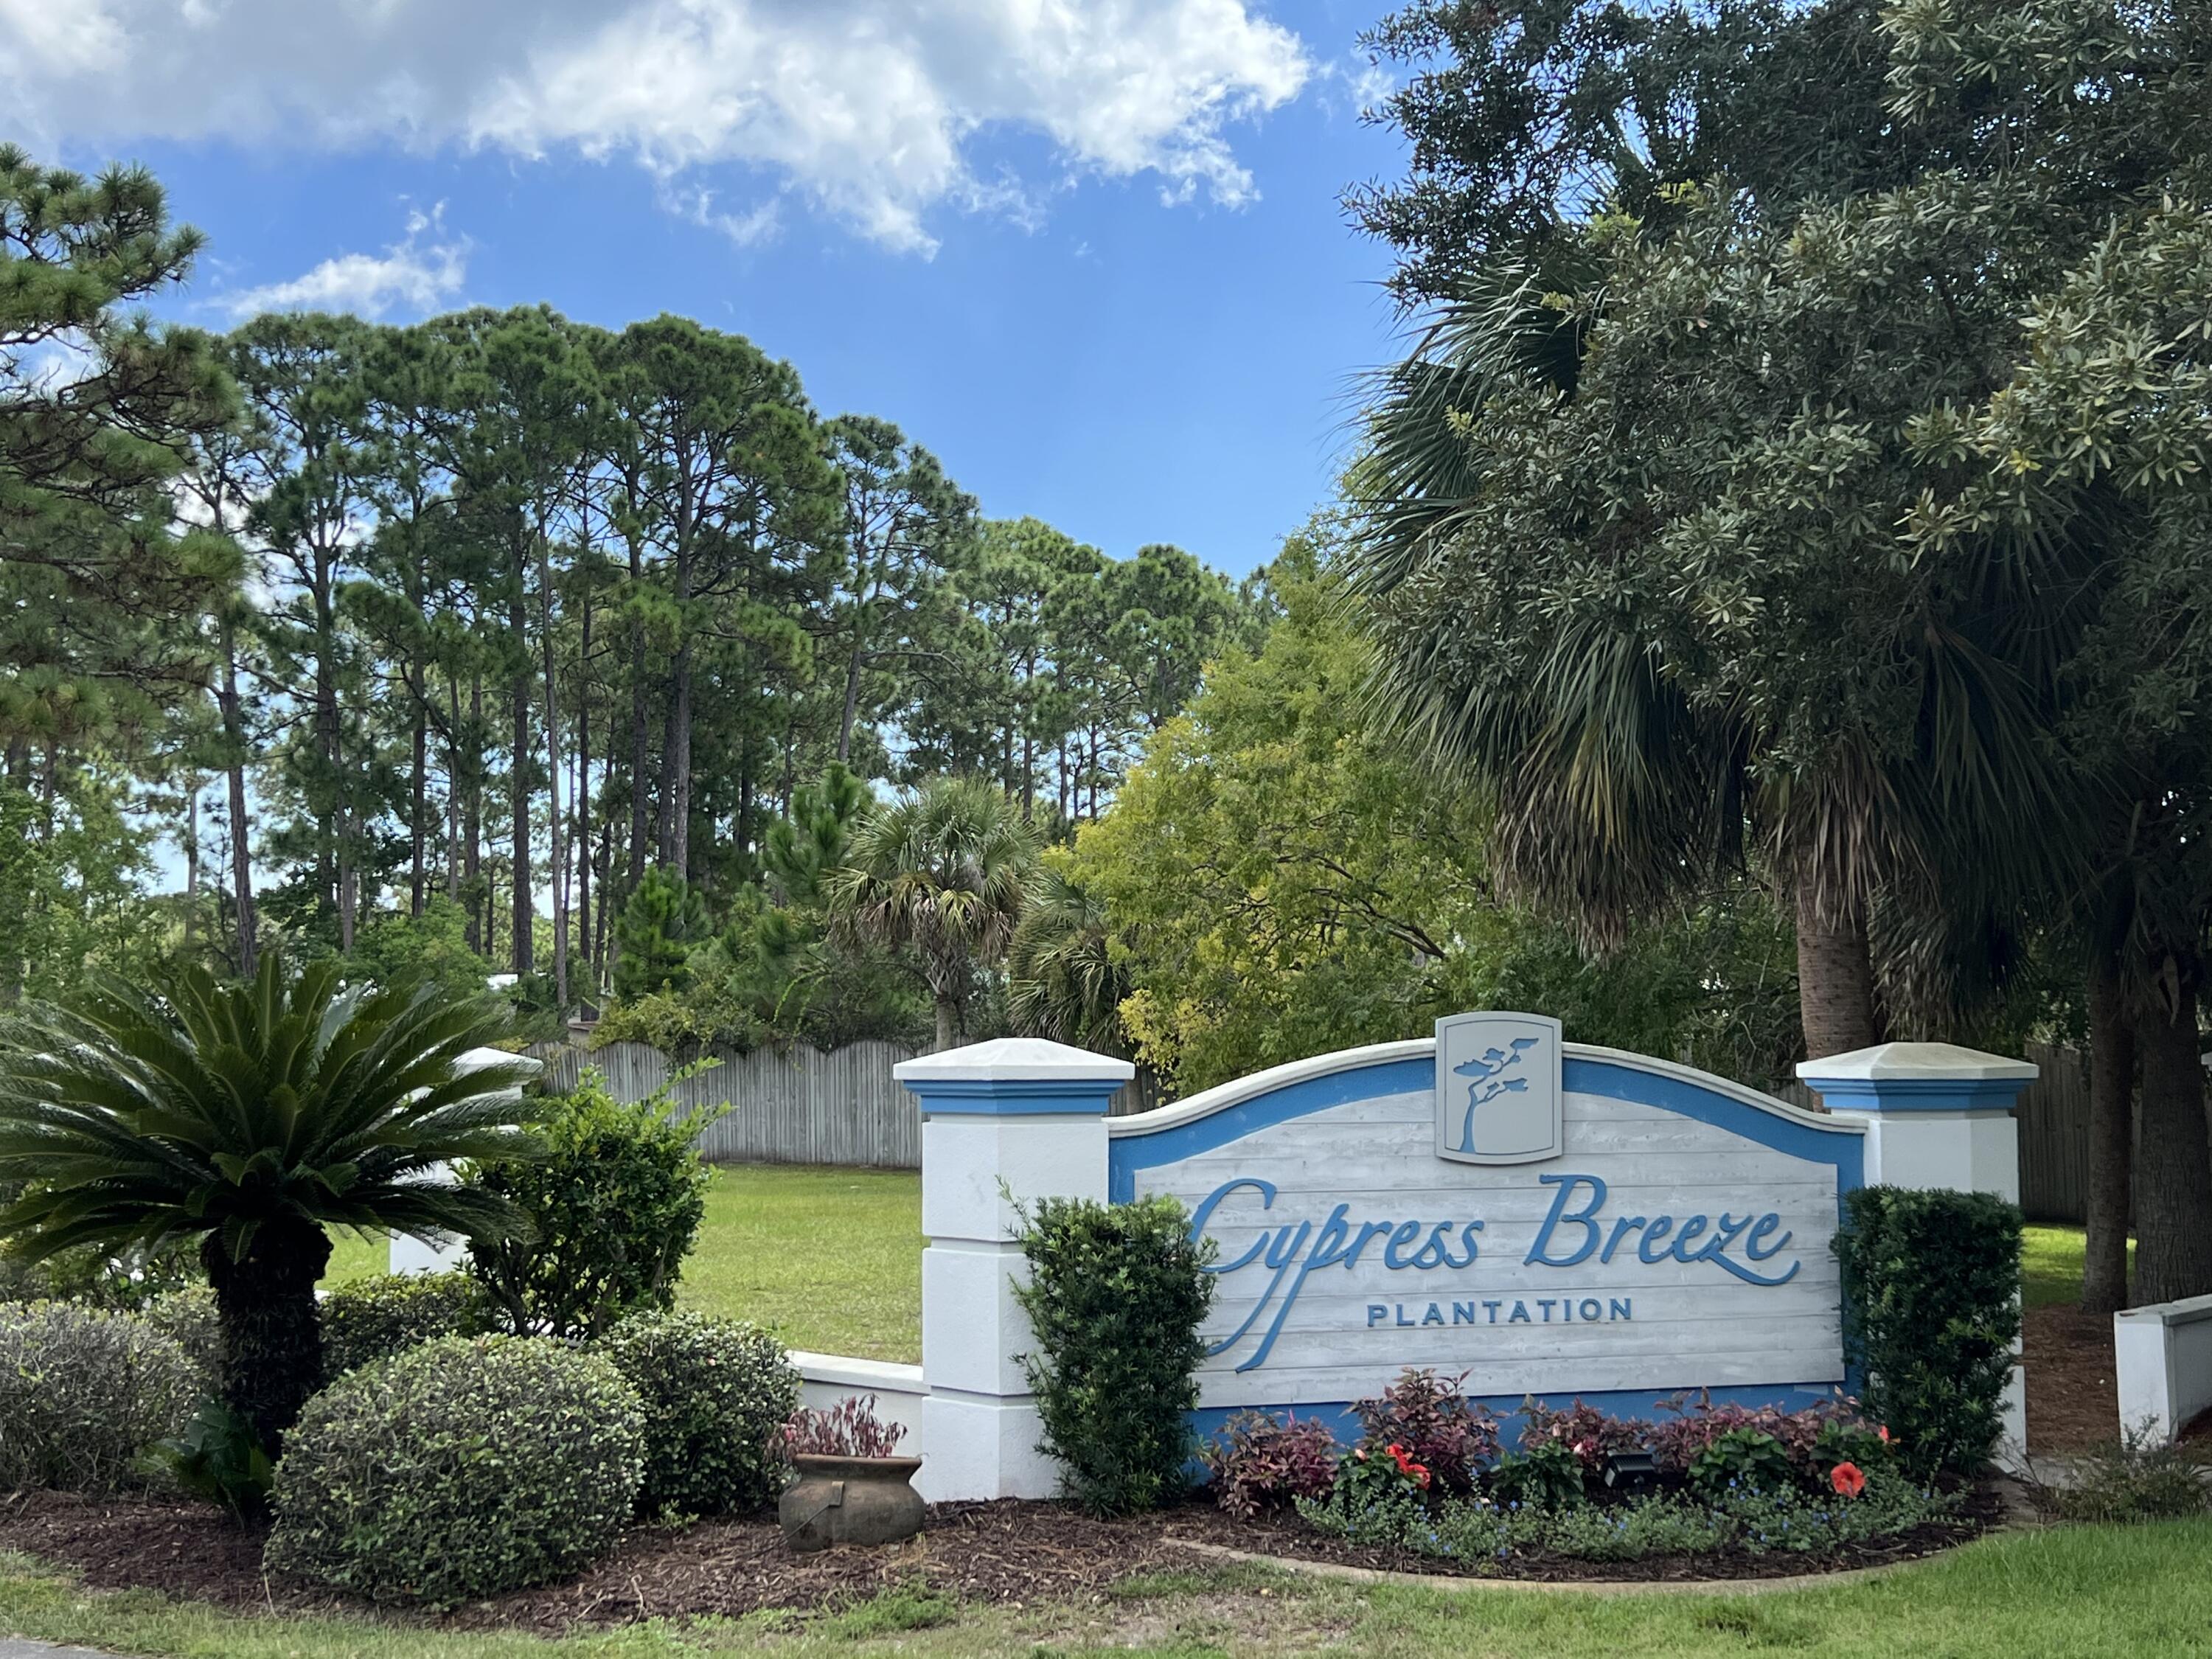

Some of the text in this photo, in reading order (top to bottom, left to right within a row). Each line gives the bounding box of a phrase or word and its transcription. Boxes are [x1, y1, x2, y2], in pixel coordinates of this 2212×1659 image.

[1189, 1175, 1801, 1373] Cypress Breeze
[1367, 1298, 1632, 1327] PLANTATION
